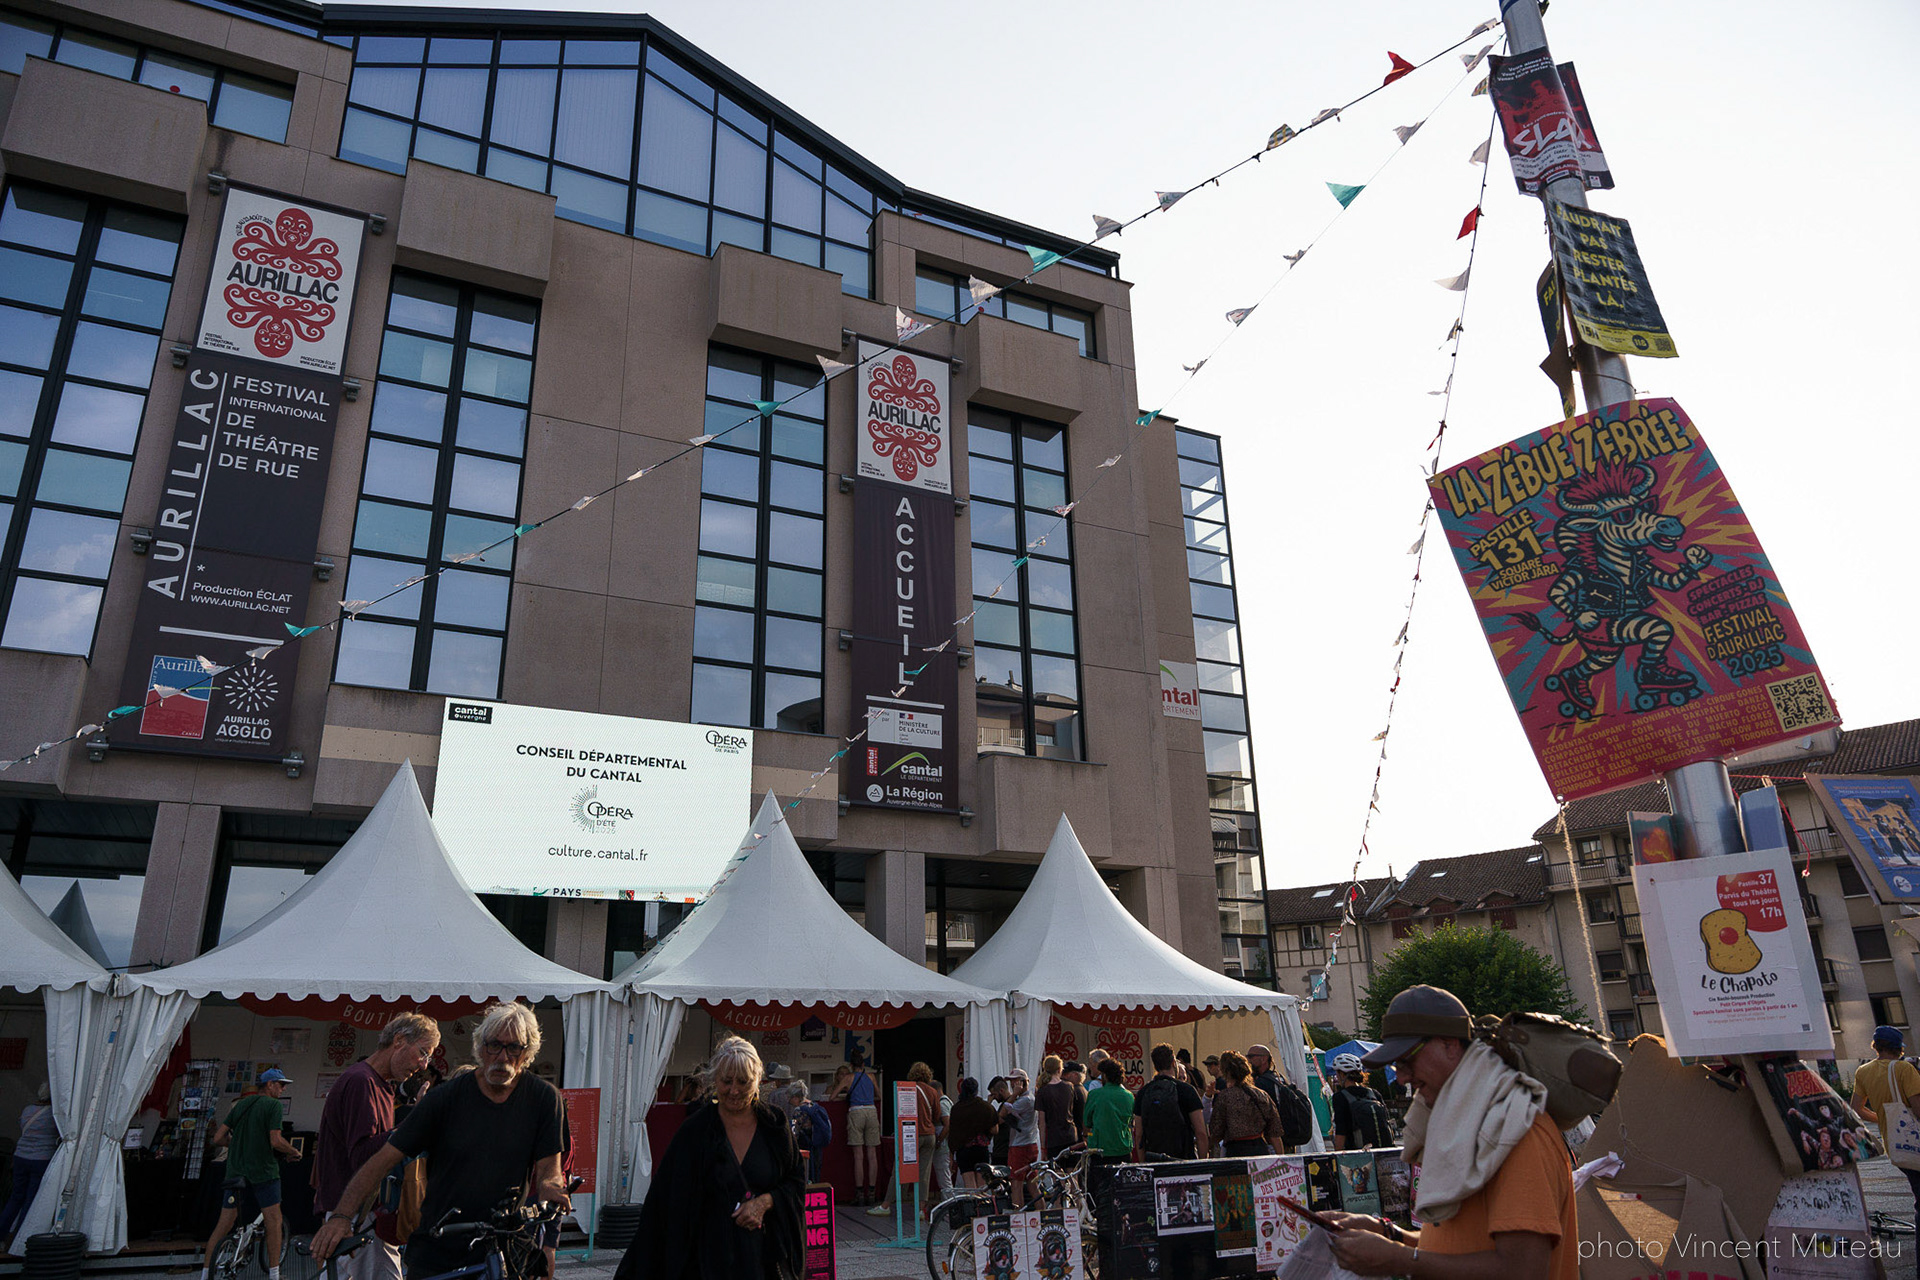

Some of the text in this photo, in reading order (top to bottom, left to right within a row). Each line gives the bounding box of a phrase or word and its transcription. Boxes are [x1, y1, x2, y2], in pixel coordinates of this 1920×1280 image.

[1556, 204, 1622, 237] FAUDRAIT
[1580, 232, 1608, 250] PAS
[1573, 249, 1628, 272] RESTER
[226, 261, 340, 304] AURILLAC
[1573, 267, 1638, 293] PLANTÉS
[233, 375, 331, 407] FESTIVAL
[226, 412, 256, 429] DE
[229, 396, 327, 423] INTERNATIONAL
[868, 400, 941, 434] AURILLAC
[222, 431, 320, 461] THÉÂTRE
[218, 453, 300, 479] DE RUE
[1443, 405, 1692, 519] LA ZÉBUE ZÉBRÉE
[147, 369, 219, 599] AURILLAC
[1469, 508, 1533, 557] PASTILLE
[1480, 526, 1544, 571] 131
[1490, 563, 1560, 591] VICTOR JARA
[1499, 557, 1542, 579] SQUARE
[193, 582, 293, 604] Production ÉCLAT
[895, 497, 915, 686] ACCUEIL
[1689, 565, 1754, 602] SPECTACLES
[190, 595, 291, 614] WWW.AURILLAC.NET
[1689, 577, 1764, 616] CONCERTS DJ
[1700, 593, 1766, 625] BAR PIZZAS
[1704, 606, 1777, 643] FESTIVAL
[155, 657, 216, 674] Aurilla
[1728, 646, 1783, 677] 2025
[1161, 687, 1198, 707] ntal
[224, 715, 270, 726] AURILLAC
[454, 706, 487, 716] cantal
[1162, 705, 1198, 717] ARTEMENT
[1542, 685, 1763, 757] ACCIDENTAL COMPANY ANONIMA TEATRO CIRQUE GONES
[216, 723, 272, 740] AGGLO
[915, 728, 941, 736] CULTURE
[1544, 694, 1767, 764] COMPAGNIE DU COIN DAKIPAYA DANZA
[1548, 702, 1769, 773] DETACHEMENT INTERNATIONAL DU MUERTO COCO
[1551, 759, 1600, 780] EPILEXIQUE
[1609, 742, 1653, 762] FADUNITO
[1708, 718, 1739, 732] NACHO
[1741, 709, 1773, 723] FLORES
[1596, 766, 1606, 775] ET
[1608, 758, 1632, 772] ELLEN
[1730, 724, 1752, 736] SLOW
[1755, 719, 1776, 730] PARK
[516, 744, 687, 770] CONSEIL DÉPARTEMENTAL
[566, 767, 642, 783] DU CANTAL
[901, 764, 942, 777] cantal
[1556, 775, 1602, 795] COMPAGNIE
[1605, 764, 1640, 780] TITANOS
[886, 785, 943, 802] La Région
[886, 799, 943, 809] Auvergne-Rhône-Alpes
[548, 844, 649, 862] culture.cantal.fr
[1758, 872, 1772, 885] 37
[553, 887, 582, 897] PAYS
[1719, 892, 1739, 900] Parvis
[1751, 887, 1776, 896] Théâtre
[1749, 898, 1760, 906] les
[1761, 896, 1779, 906] jours
[1760, 906, 1782, 919] 17h
[1701, 974, 1716, 990] Le
[344, 1004, 422, 1025] BOUTIE
[724, 1009, 783, 1027] ACCUEIL
[837, 1012, 891, 1027] PUBLIC
[1093, 1012, 1174, 1026] BILLETTERIE
[1253, 1163, 1291, 1186] GUINGUETTE
[1260, 1174, 1304, 1196] DES ÉLEVEURS
[985, 1230, 1017, 1246] DOPAMINE
[1038, 1225, 1070, 1240] DOPAMINE
